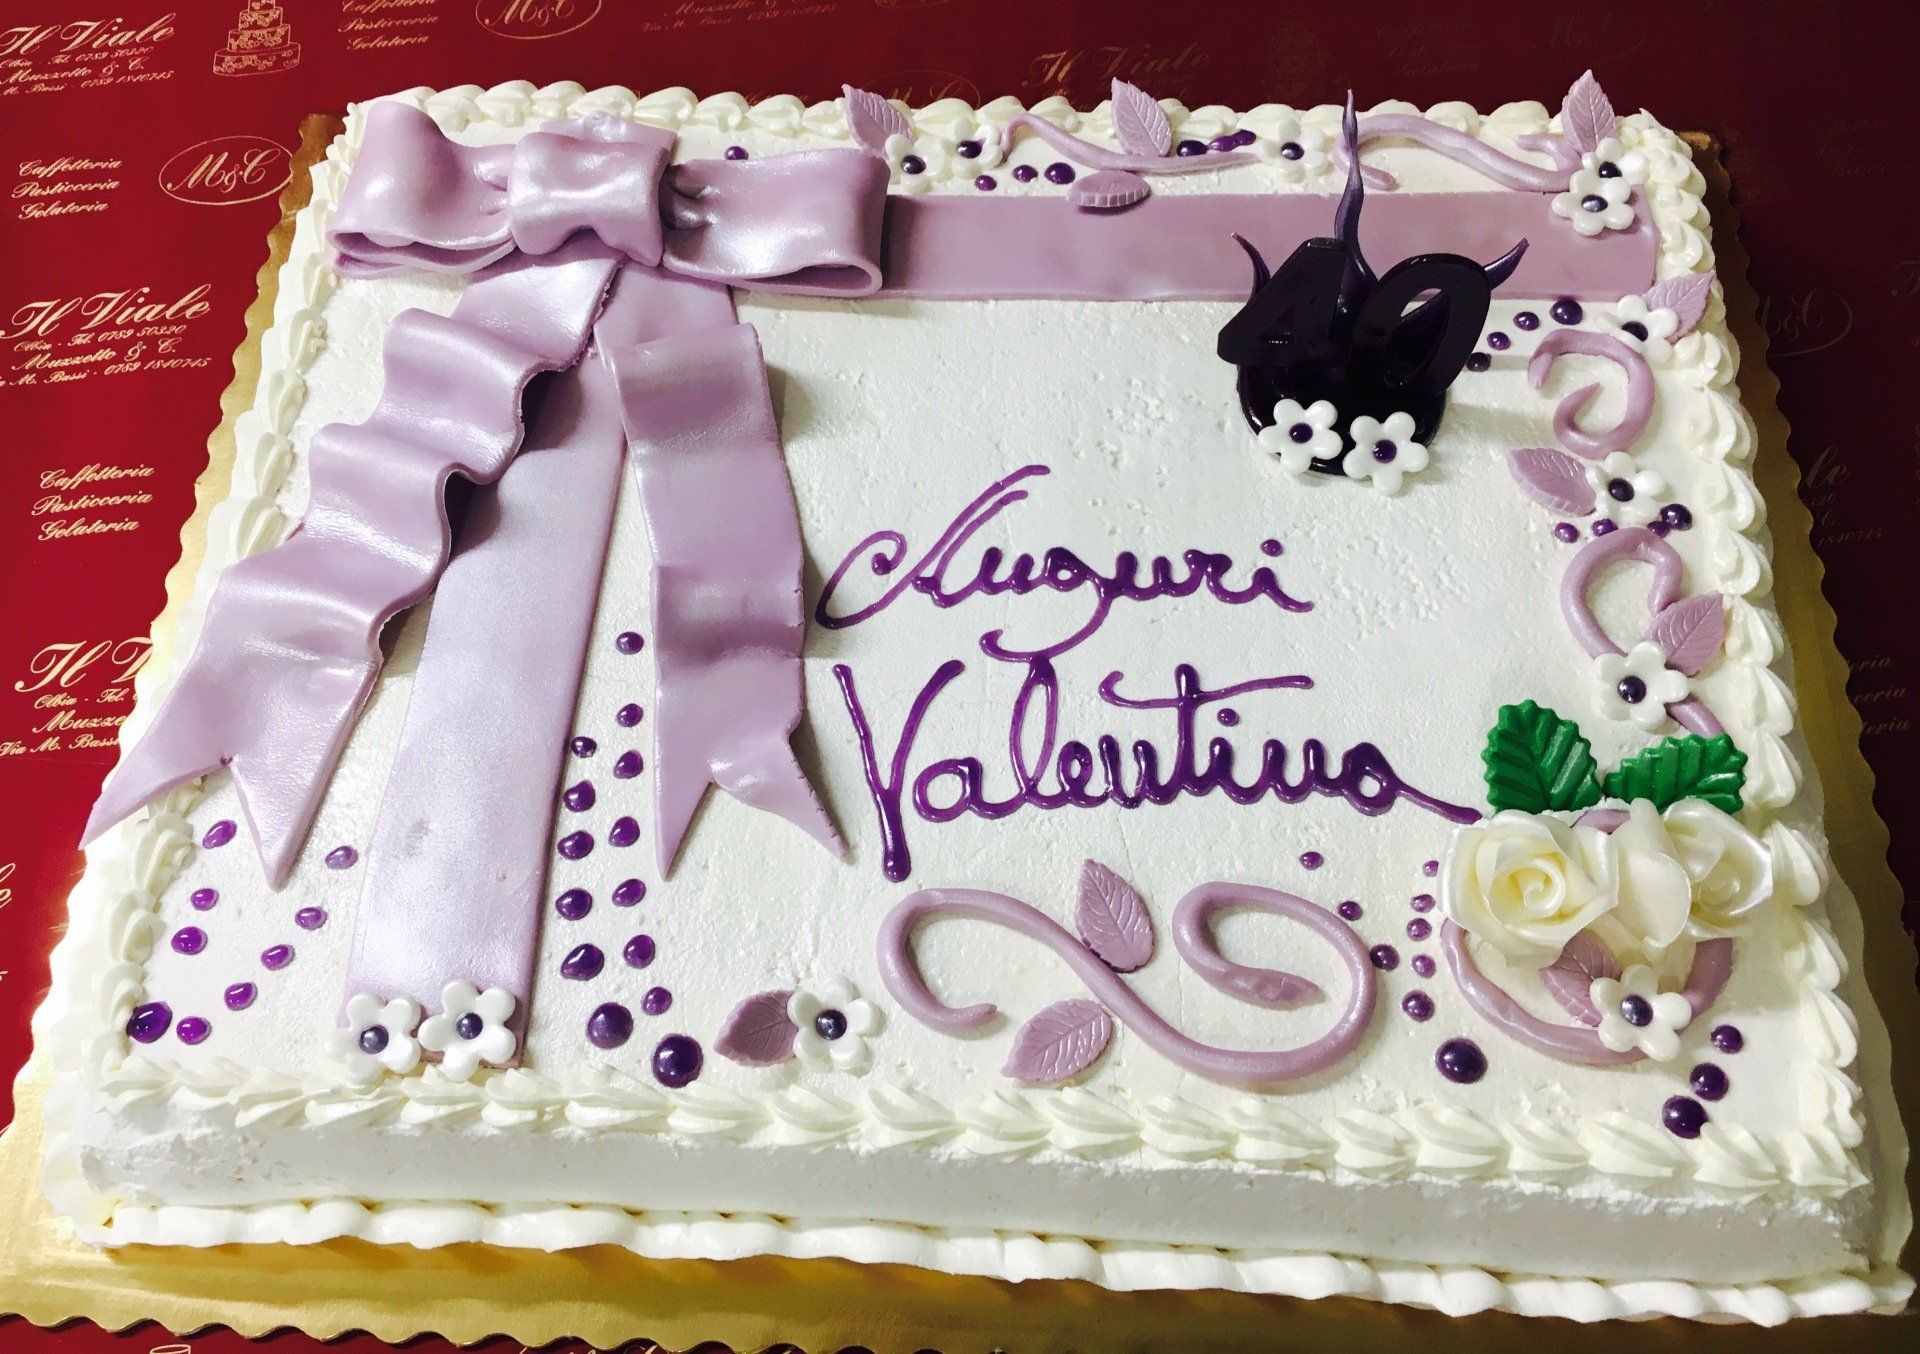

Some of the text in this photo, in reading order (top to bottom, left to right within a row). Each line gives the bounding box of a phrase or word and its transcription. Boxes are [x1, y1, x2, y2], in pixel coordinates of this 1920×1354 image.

[60, 12, 177, 53] Viale
[19, 156, 122, 179] Caffetteria
[12, 178, 121, 200] Pasticceria
[18, 200, 109, 220] Gelateria
[0, 283, 212, 340] Il Viale
[14, 339, 53, 353] Olbia
[67, 331, 96, 347] Tel.
[97, 329, 135, 343] 0789
[11, 337, 183, 371] Muzzetto & C.
[104, 361, 141, 376] 0789
[143, 357, 213, 371] 1840745
[40, 463, 155, 490] Caffetteria
[31, 490, 154, 517] Pasticceria
[38, 517, 140, 542] Gelateria
[815, 464, 1314, 662] Auguri
[14, 639, 113, 693] Il
[34, 692, 78, 709] Olbia
[96, 687, 130, 704] Tel.
[31, 709, 127, 734] Muzze
[30, 736, 61, 753] M.
